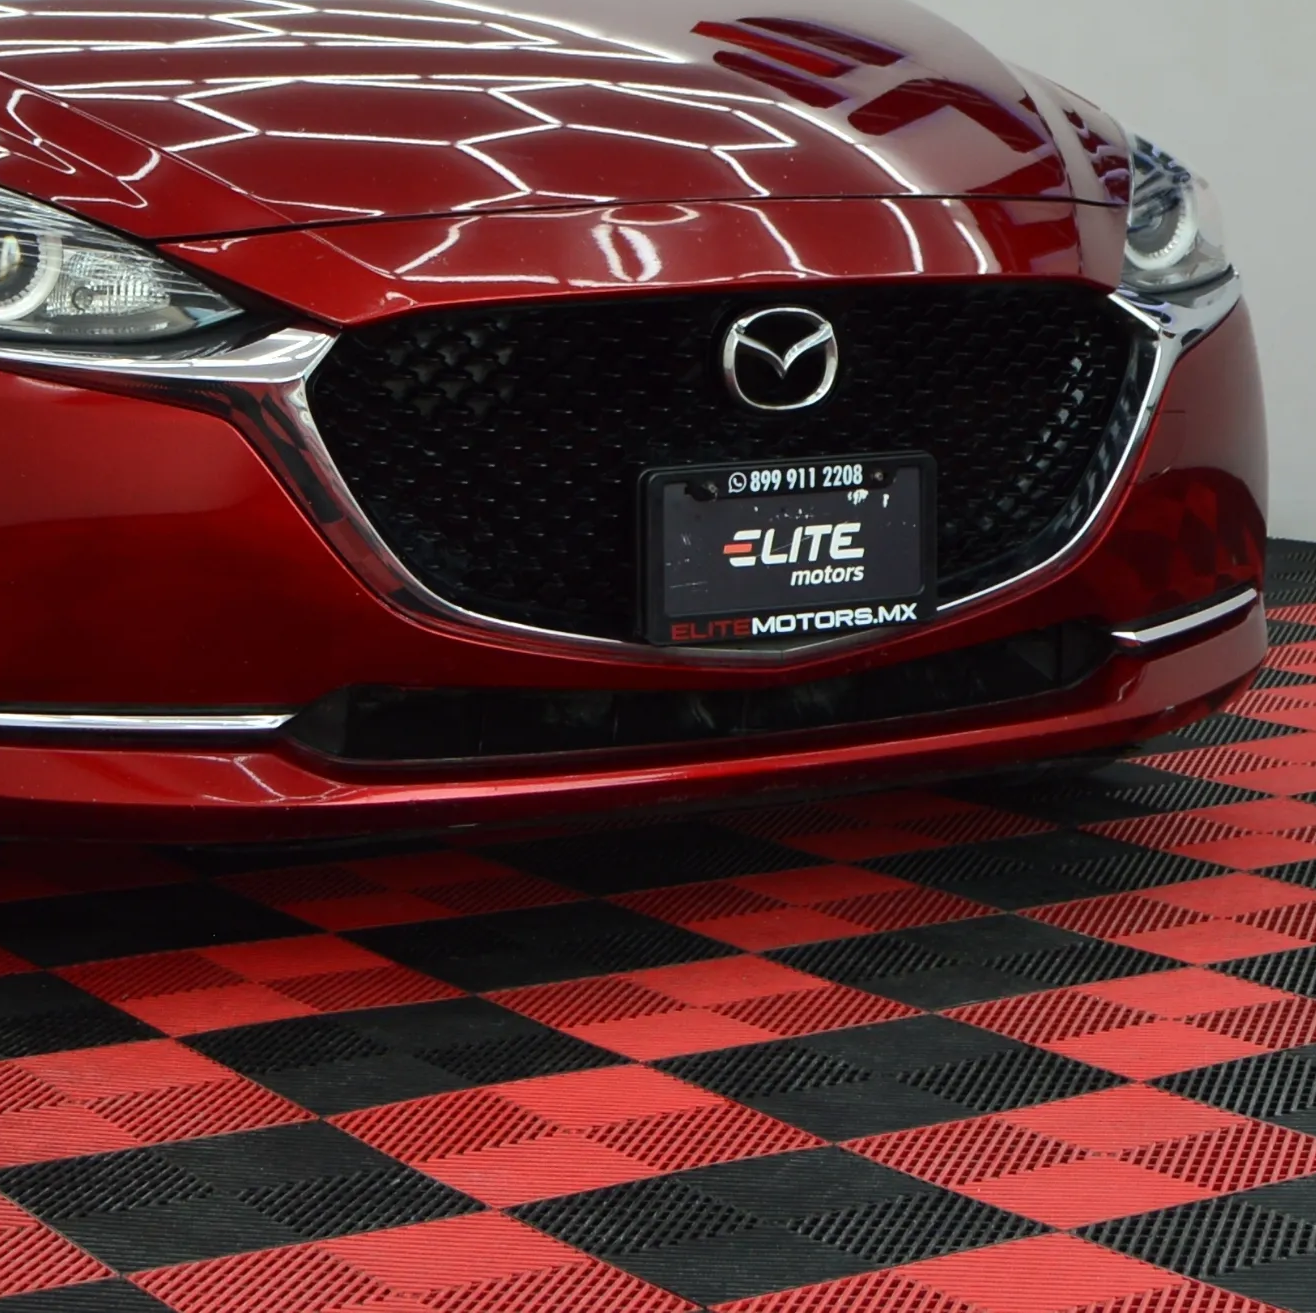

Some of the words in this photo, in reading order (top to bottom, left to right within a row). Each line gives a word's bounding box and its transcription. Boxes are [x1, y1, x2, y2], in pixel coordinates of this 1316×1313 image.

[749, 469, 781, 492] 899
[787, 467, 816, 490] 911
[822, 464, 863, 487] 2208
[723, 522, 865, 567] ELITE
[790, 565, 865, 586] motors
[671, 603, 918, 641] ELITEMOTORS.MX
